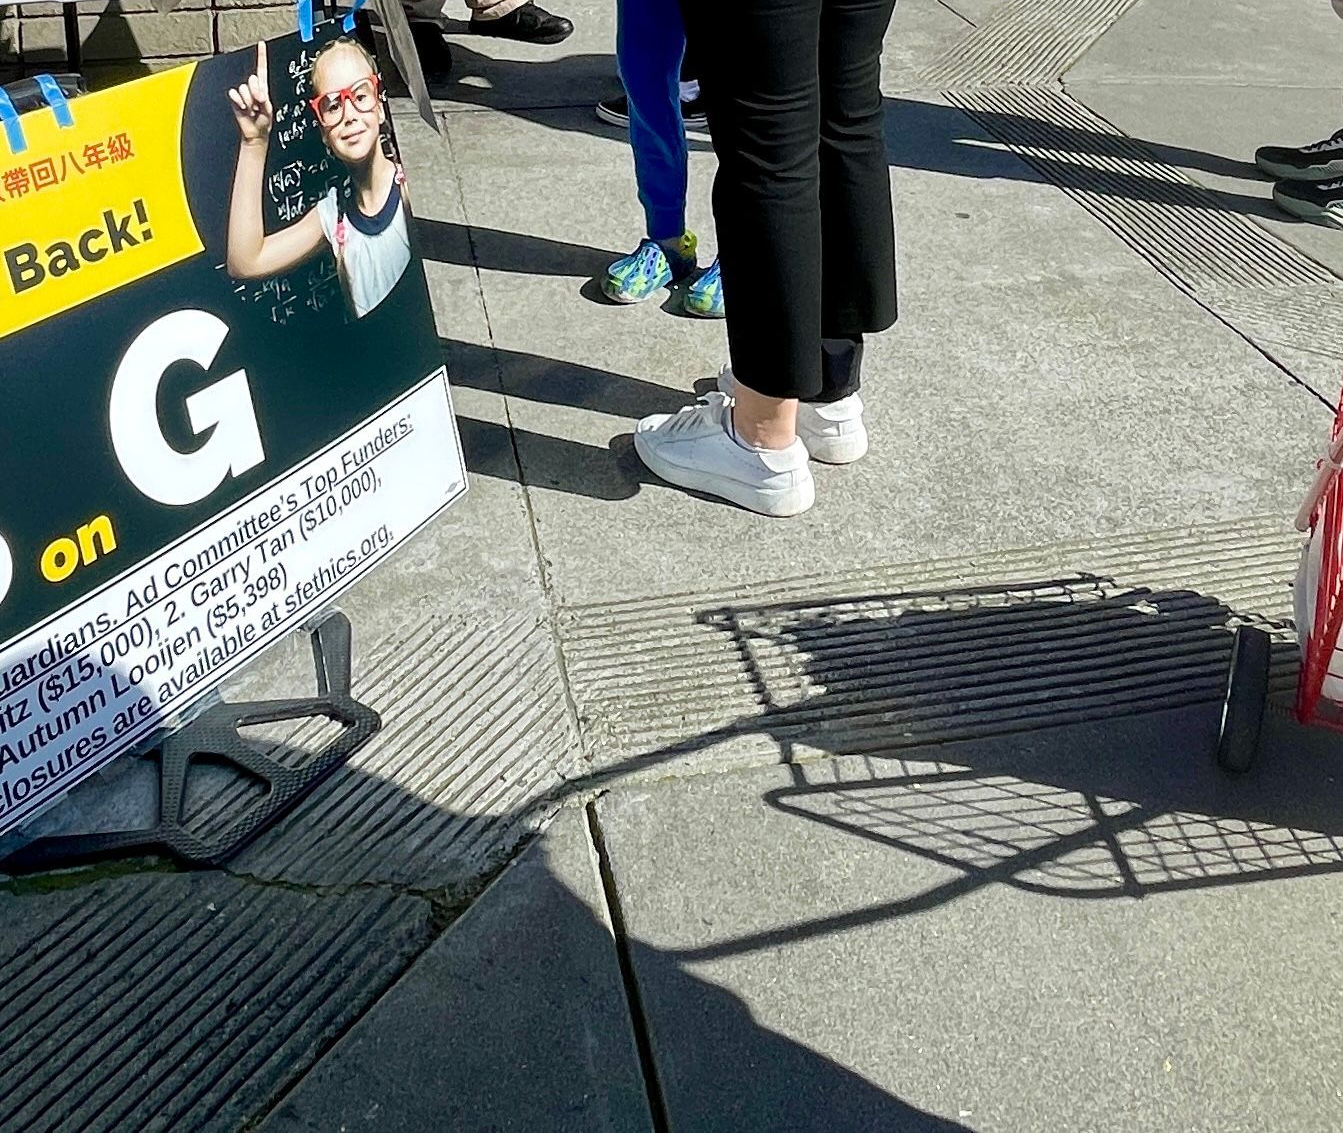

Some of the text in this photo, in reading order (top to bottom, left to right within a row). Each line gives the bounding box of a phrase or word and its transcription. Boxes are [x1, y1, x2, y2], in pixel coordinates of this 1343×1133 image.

[3, 198, 154, 294] Back!
[41, 515, 117, 583] on
[109, 309, 266, 506] G
[126, 577, 156, 617] Ad
[164, 496, 298, 592] Committee's
[302, 468, 338, 499] Top
[341, 414, 414, 474] Funders:
[38, 616, 162, 712] ($15,000),
[164, 600, 186, 626] 2.
[191, 555, 252, 606] Garry
[255, 528, 295, 563] Tan
[299, 468, 382, 541] ($10,000),
[111, 626, 202, 698] Looijen
[206, 563, 288, 638] ($5,398)
[112, 697, 153, 735] are
[158, 621, 256, 704] available
[262, 610, 282, 632] at
